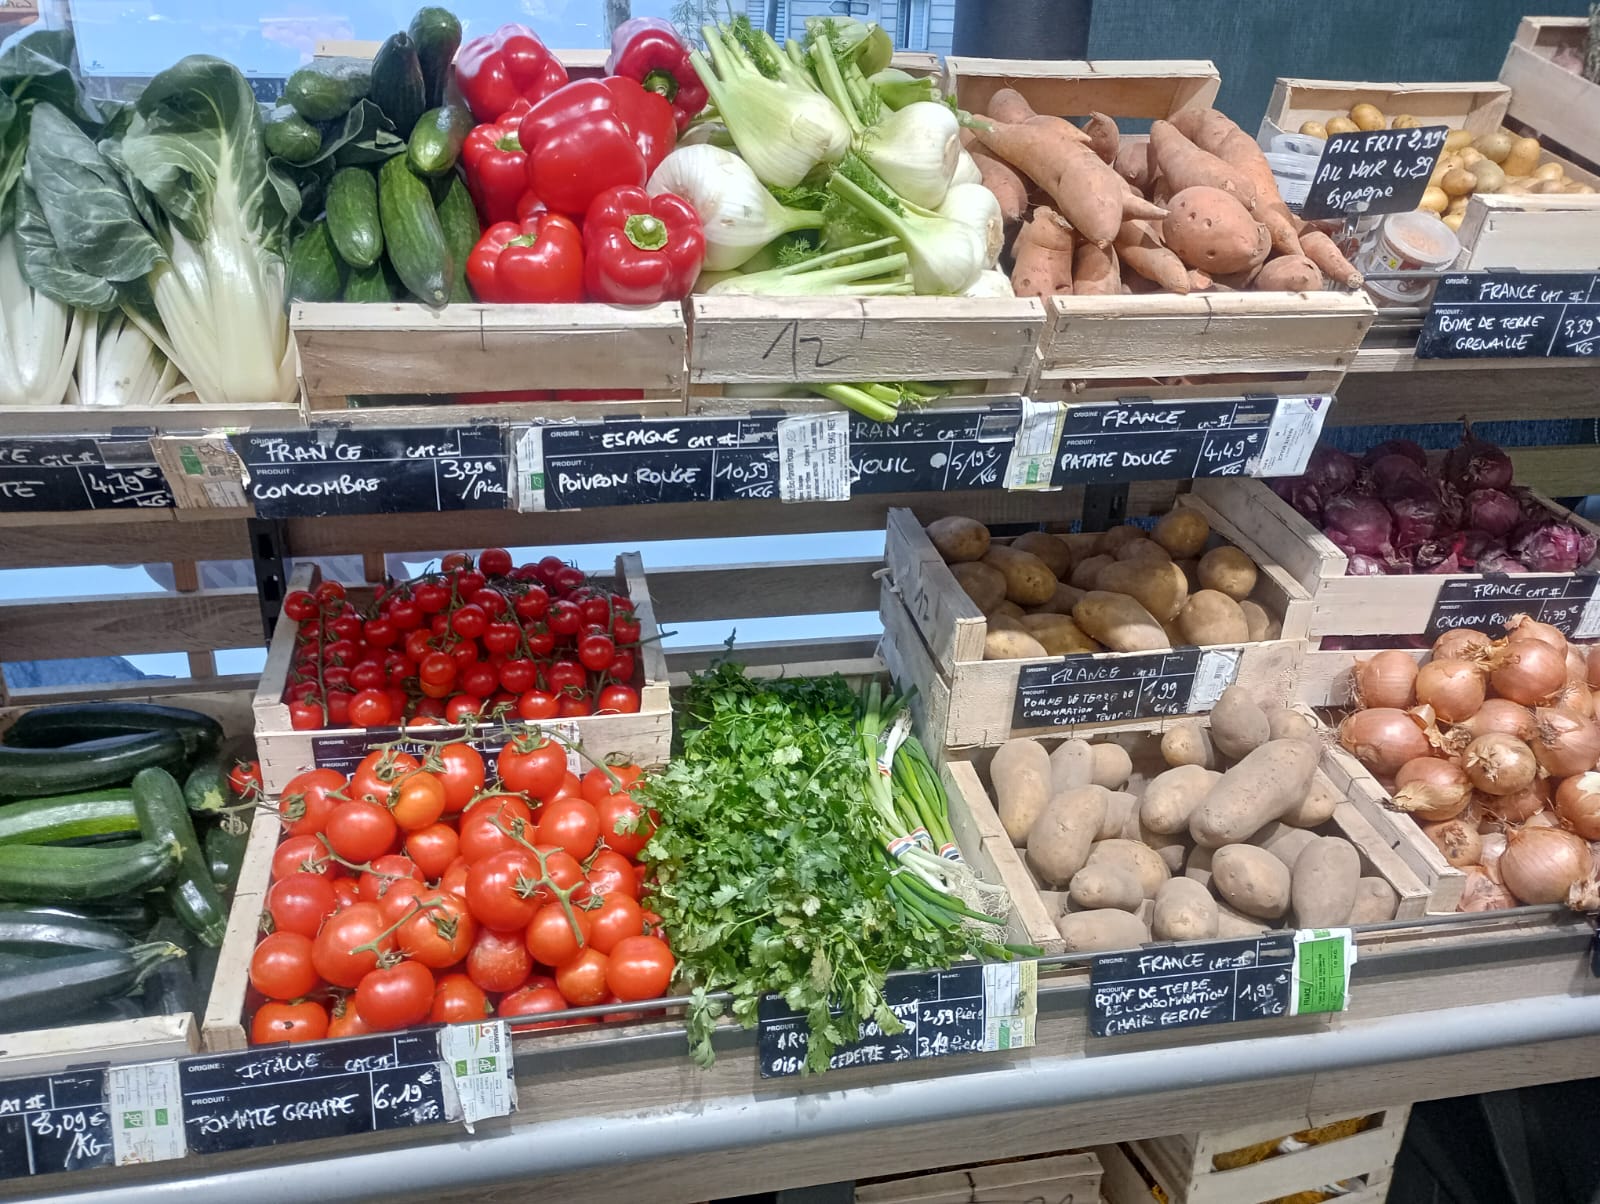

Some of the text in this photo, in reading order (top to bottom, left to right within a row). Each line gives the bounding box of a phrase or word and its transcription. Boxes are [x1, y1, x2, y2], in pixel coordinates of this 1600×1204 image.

[1328, 138, 1360, 154] AIL
[1365, 135, 1407, 152] FRIT
[1317, 165, 1343, 184] AIL
[1348, 160, 1386, 179] NOIR
[1327, 185, 1394, 209] Espagne
[1479, 283, 1542, 300] FRANCE
[1477, 317, 1496, 330] DE
[1499, 315, 1545, 329] TERRE
[1455, 334, 1534, 351] GRENAILLE
[1102, 409, 1187, 429] FRANCE
[601, 428, 681, 449] ESPAGNE
[687, 436, 714, 448] CAT
[406, 444, 436, 458] CAT
[1061, 449, 1178, 471] PATATE DOUCE
[253, 475, 381, 499] CONCOMBRE
[558, 463, 702, 492] POIVRON ROUGE
[1473, 583, 1527, 598] FRANCE
[1525, 587, 1549, 598] CAT
[1436, 613, 1513, 629] OIGNON ROU
[1051, 666, 1120, 684] FRANCE
[1122, 689, 1135, 699] DE
[1137, 953, 1205, 975] FRANCE
[1138, 986, 1158, 1000] DE
[1160, 979, 1212, 996] TERRE
[1105, 1013, 1155, 1036] CHAIR
[235, 1053, 322, 1079] ITALIE
[32, 1111, 107, 1138] 8,09€
[186, 1093, 359, 1136] TOMATE GRAPPE
